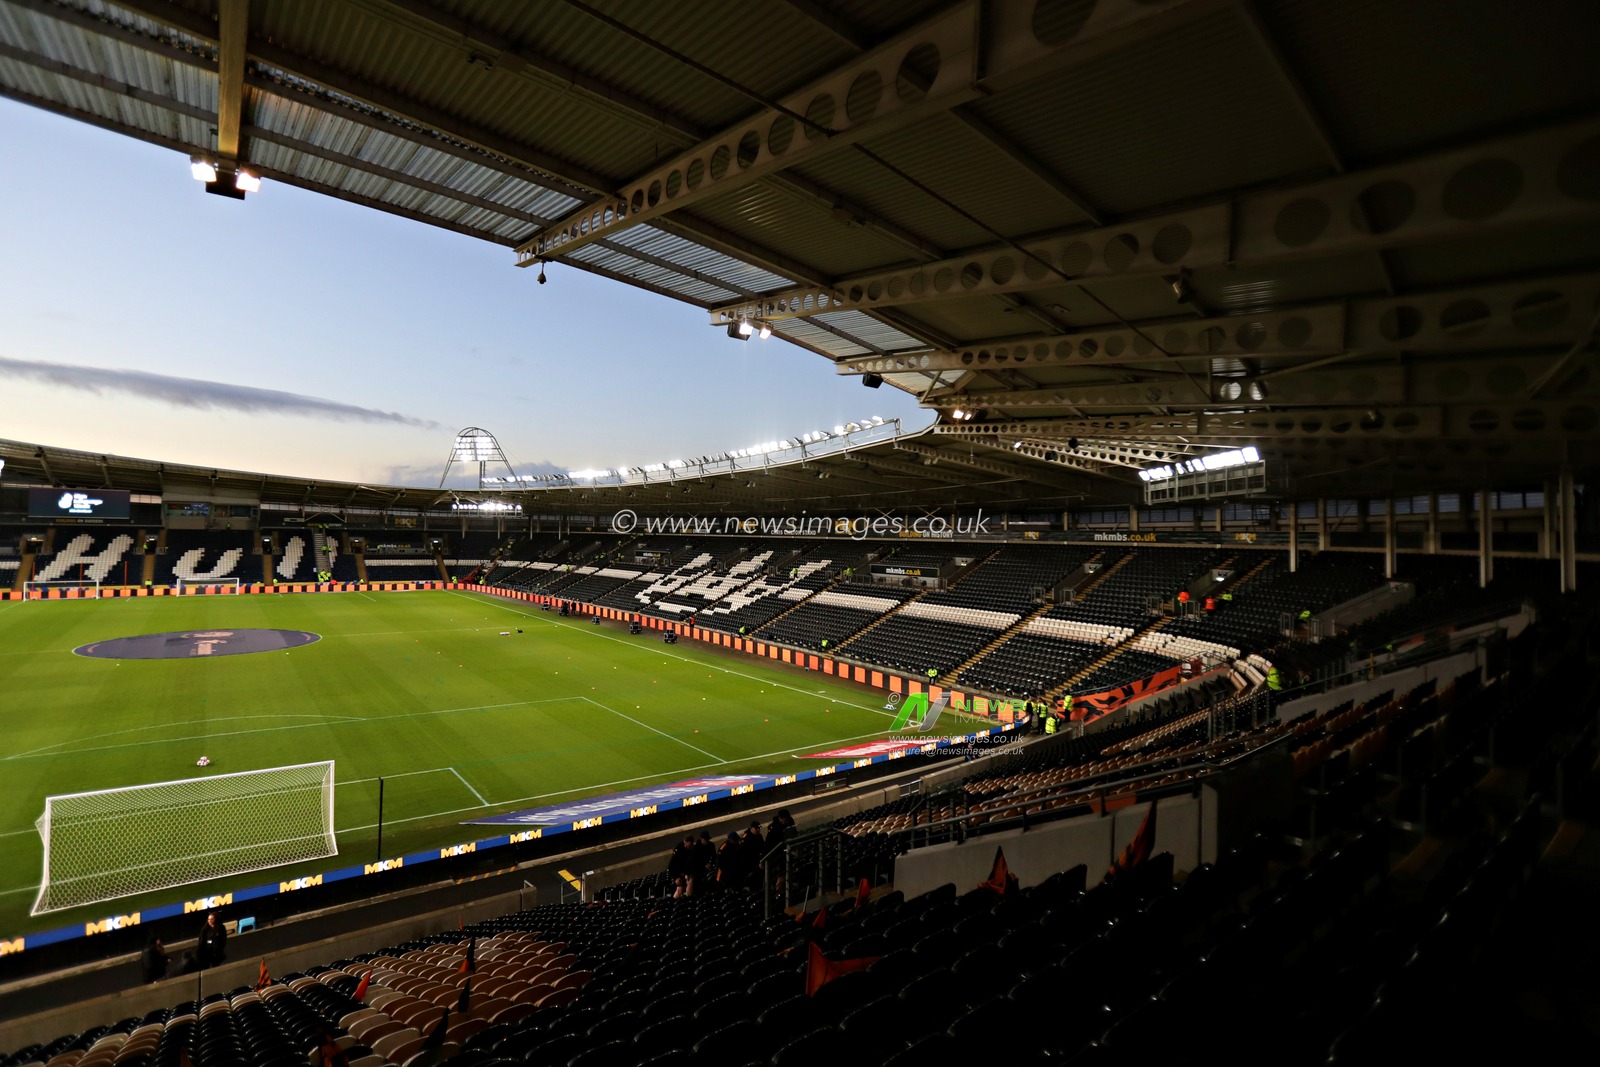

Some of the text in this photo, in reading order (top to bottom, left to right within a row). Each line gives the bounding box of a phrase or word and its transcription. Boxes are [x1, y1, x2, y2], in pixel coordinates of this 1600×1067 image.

[1094, 533, 1156, 542] mkmbs.co.uk
[1235, 533, 1257, 543] MKM
[886, 567, 921, 576] mkmbs.co.uk
[854, 758, 872, 768] MKM
[816, 766, 836, 777] MKM
[775, 775, 796, 786] MKM
[731, 784, 754, 796] MKM
[683, 794, 708, 807] MKM
[630, 805, 657, 818] MKM
[573, 816, 602, 831] MKM
[509, 829, 542, 844] MKM
[440, 842, 476, 858] MKM
[364, 857, 403, 875] MKM
[279, 874, 323, 893] MKM
[184, 893, 233, 914] MKM
[85, 912, 141, 936] MKM
